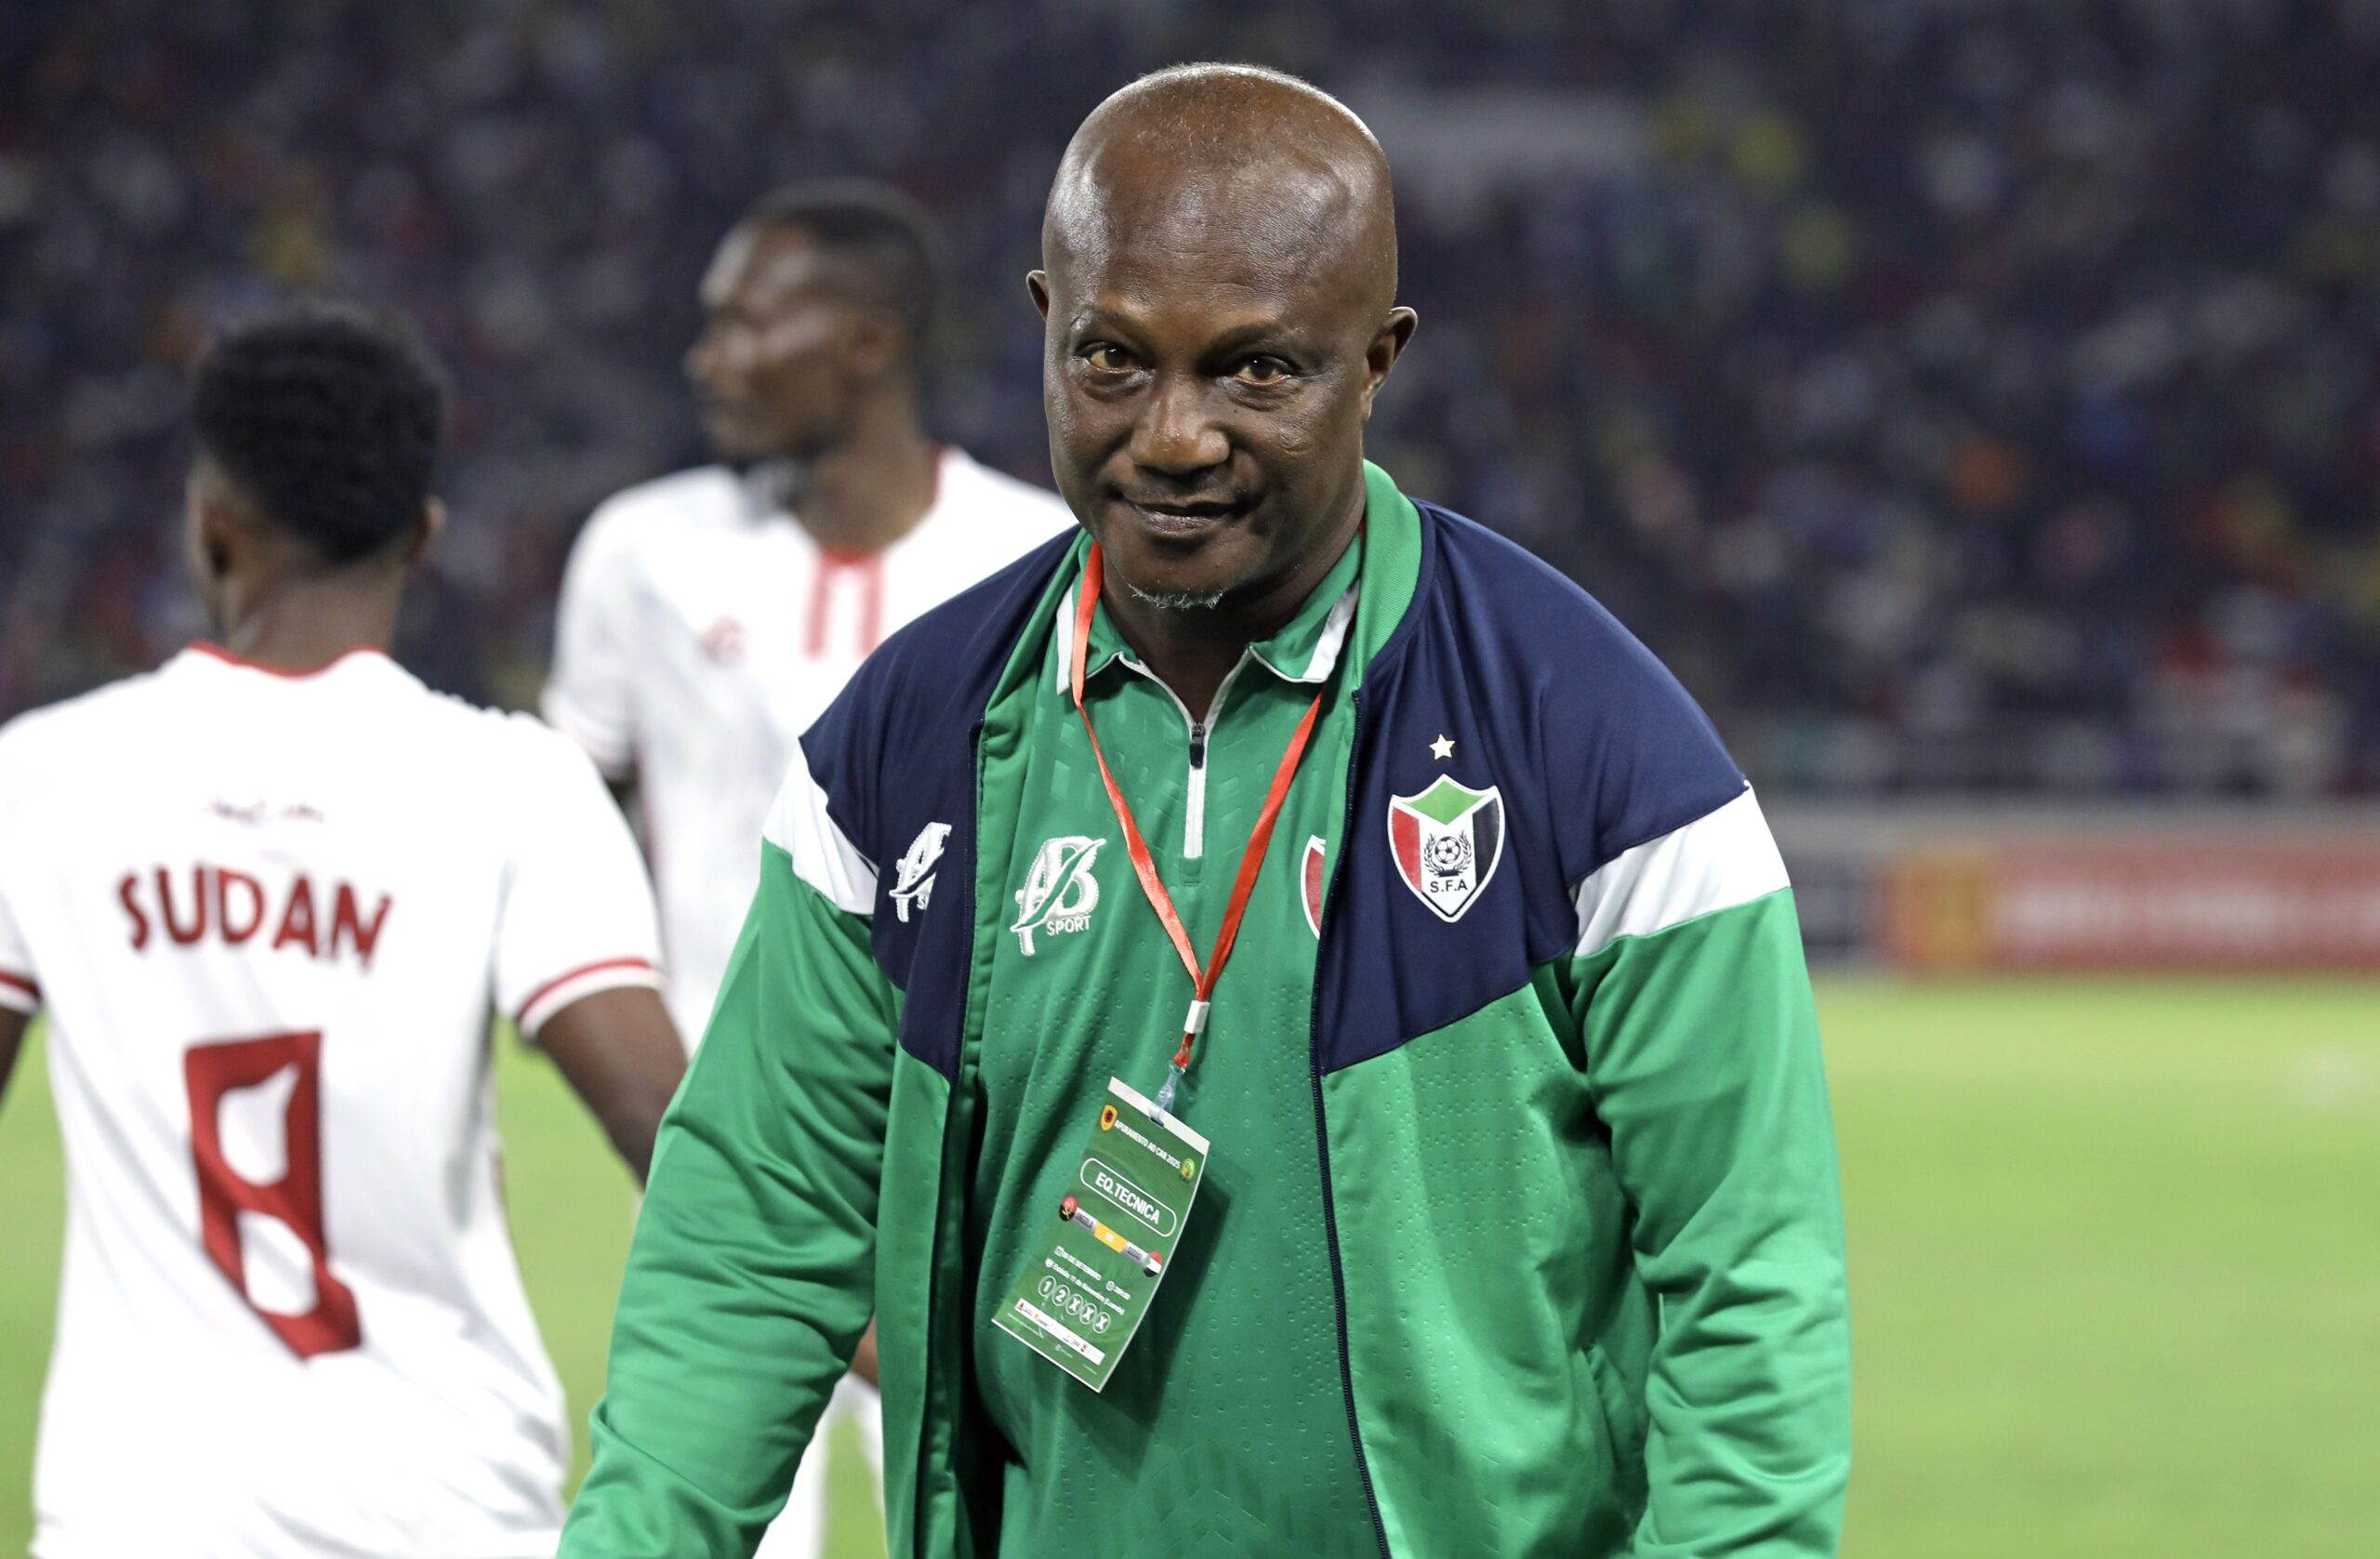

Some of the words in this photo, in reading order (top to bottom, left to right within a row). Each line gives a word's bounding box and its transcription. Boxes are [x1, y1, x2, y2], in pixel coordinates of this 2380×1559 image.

[1430, 879, 1468, 893] S.F.A
[118, 862, 391, 972] SUDAN
[1046, 915, 1091, 935] SPORT
[183, 1030, 364, 1363] 8
[1094, 1170, 1161, 1226] EQ.TECNICA
